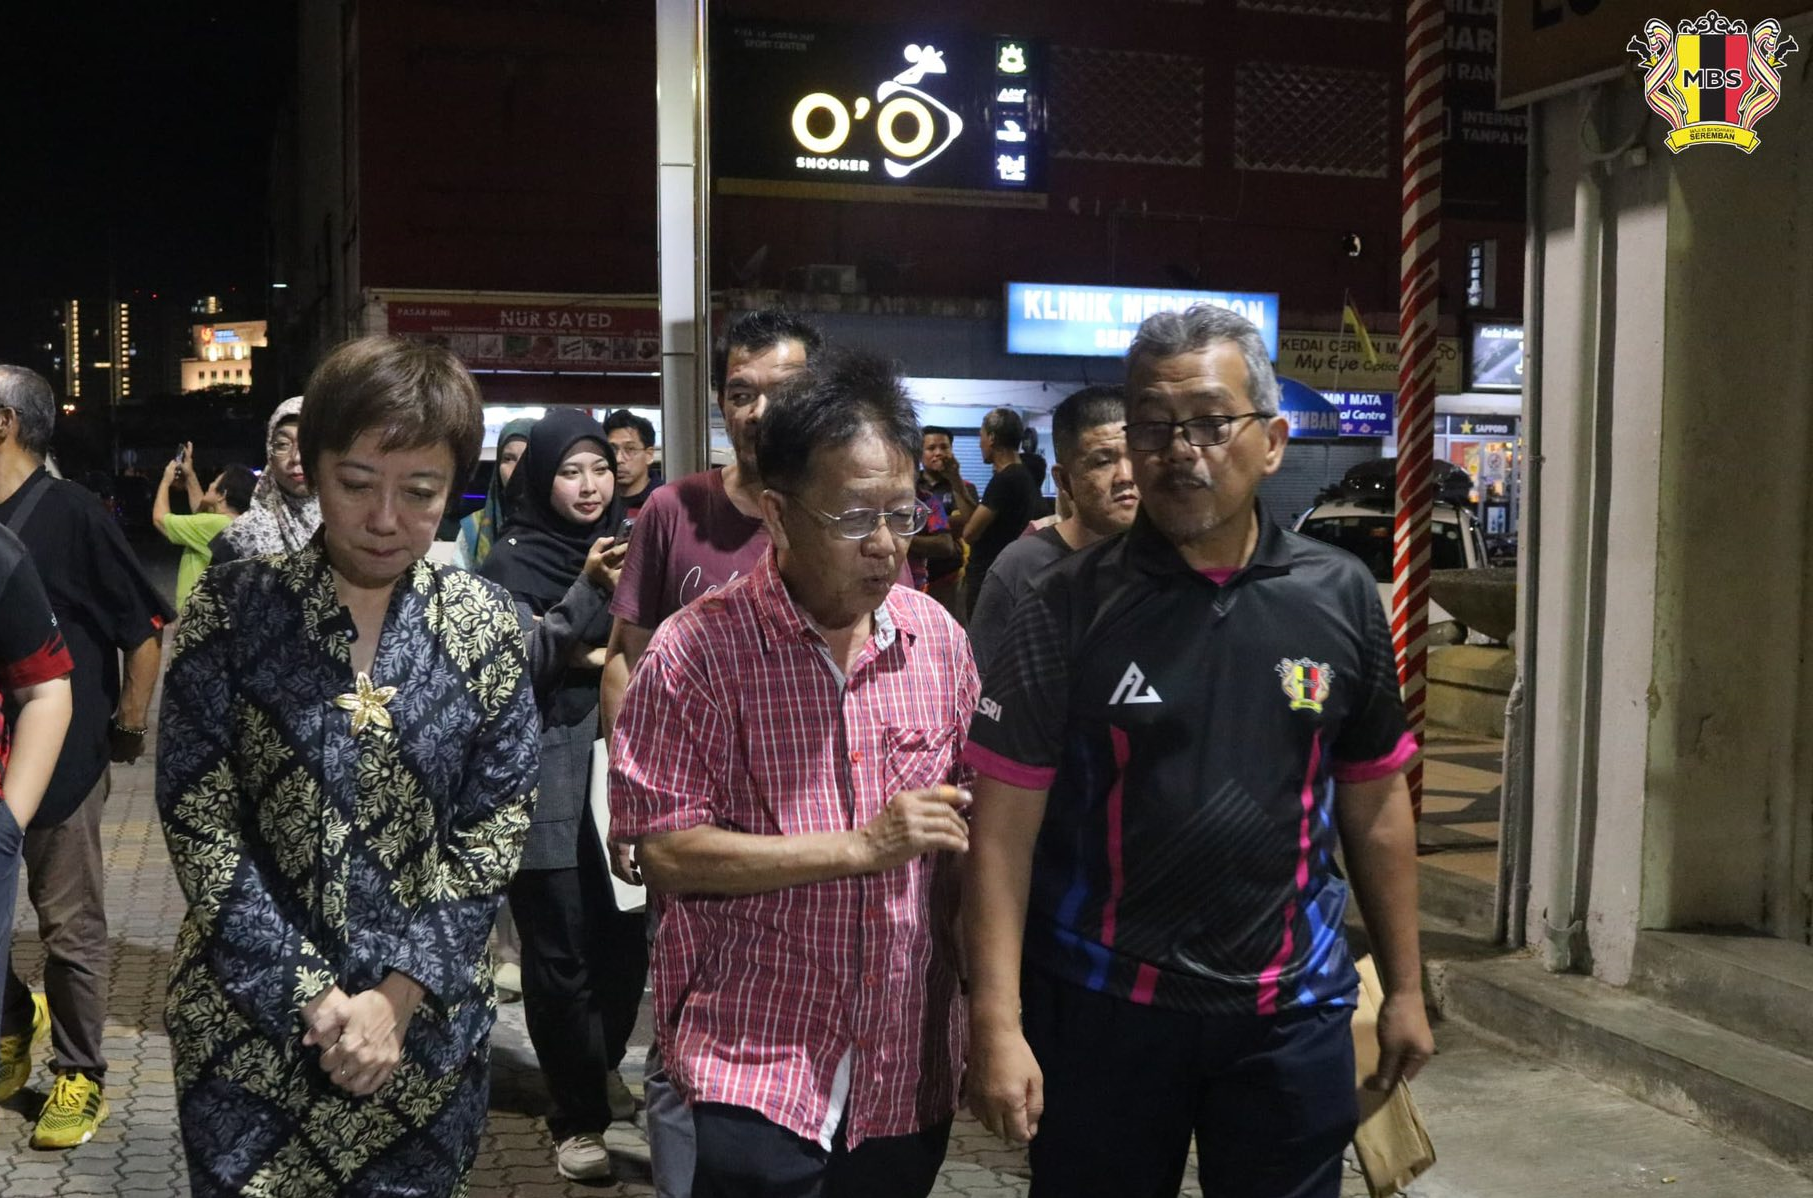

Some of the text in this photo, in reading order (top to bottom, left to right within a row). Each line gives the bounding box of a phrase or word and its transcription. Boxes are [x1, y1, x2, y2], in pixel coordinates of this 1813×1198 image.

[1462, 128, 1509, 144] TANPA
[796, 156, 870, 172] SNOOKER
[1024, 289, 1114, 322] KLINIK
[500, 308, 613, 328] NUR SAYED
[1281, 338, 1323, 352] KEDAI
[1295, 354, 1323, 372] My
[1327, 355, 1359, 374] Eye
[1349, 393, 1382, 405] MATA
[1352, 409, 1386, 421] Centre
[1475, 424, 1508, 434] SAPPORO
